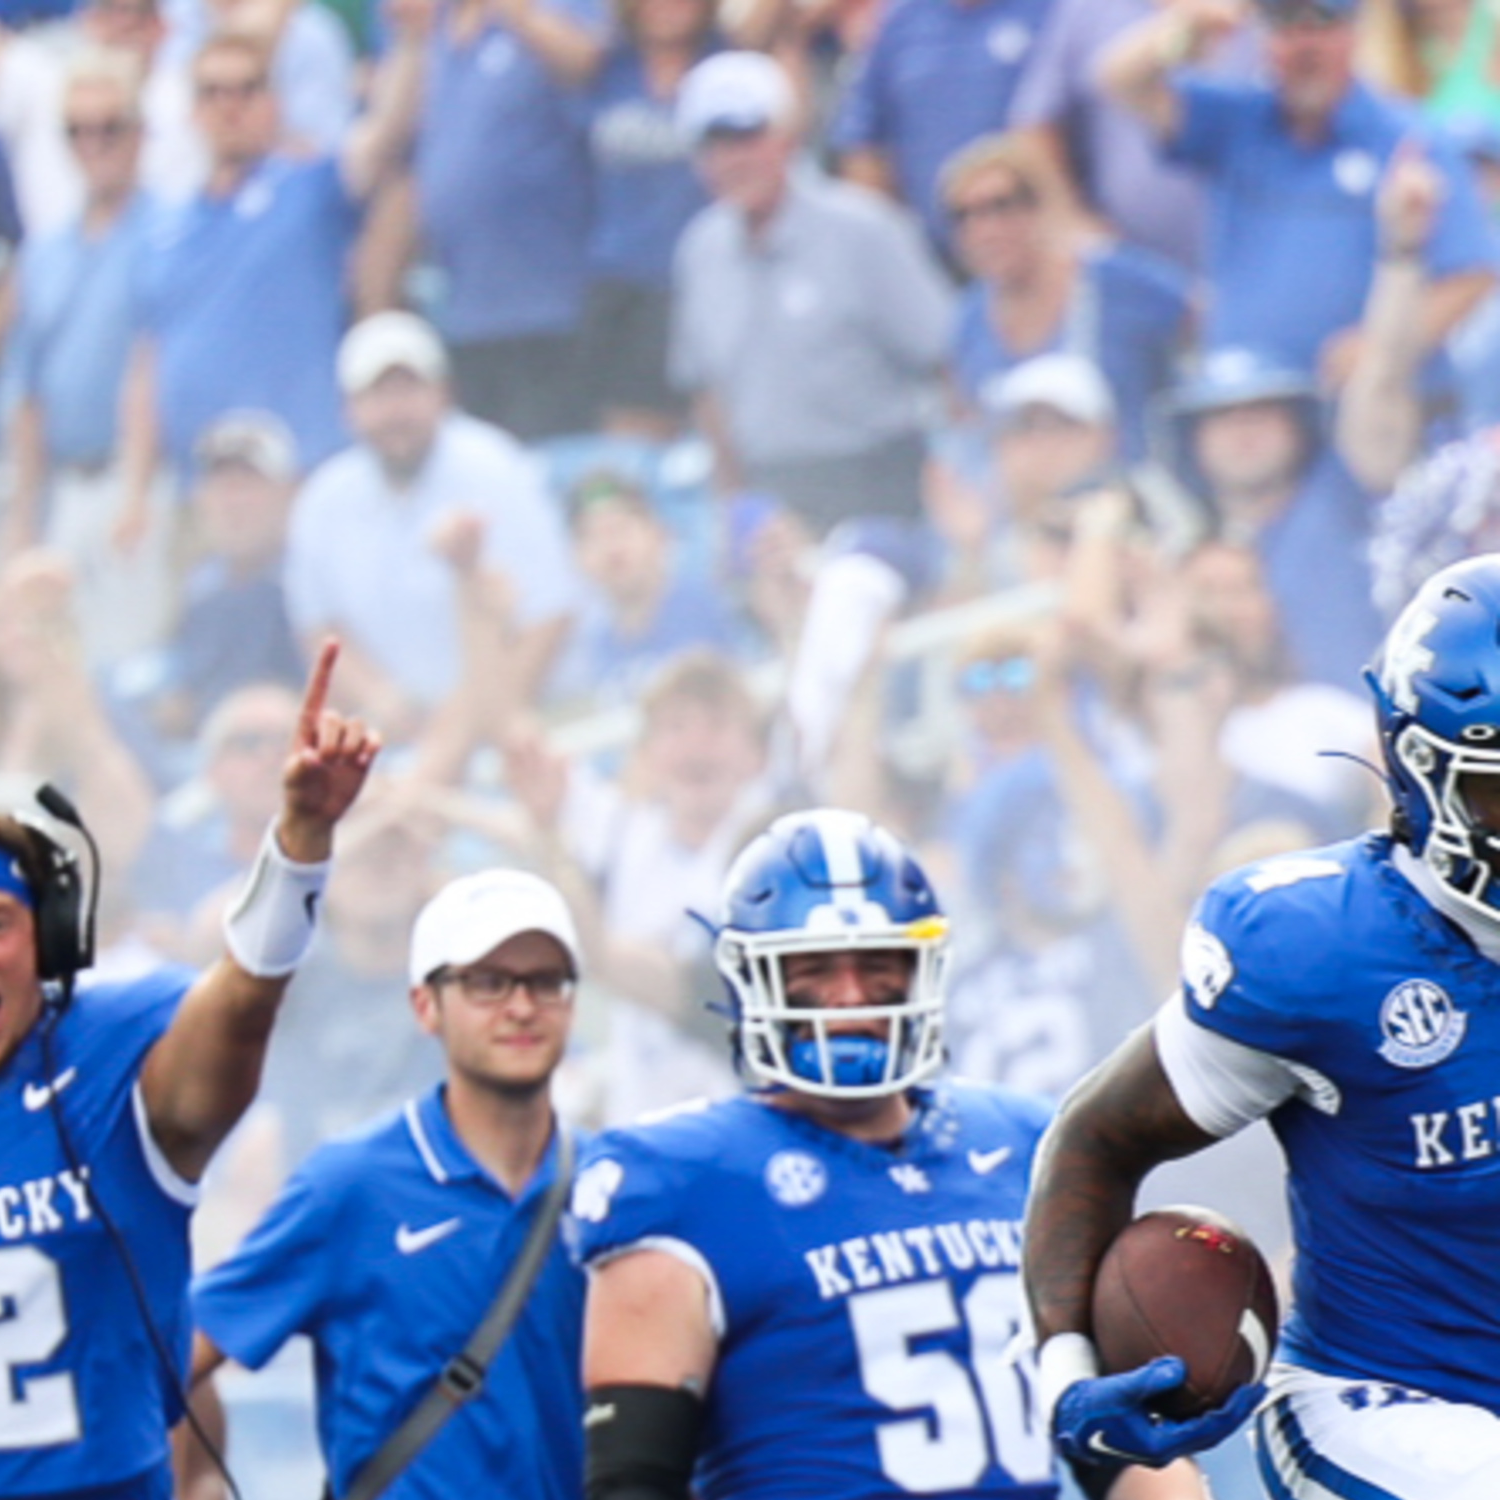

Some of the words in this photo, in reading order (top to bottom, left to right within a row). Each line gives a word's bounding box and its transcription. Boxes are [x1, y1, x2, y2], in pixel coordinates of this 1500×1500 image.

[1384, 982, 1450, 1048] SEC
[1409, 1096, 1500, 1168] KE
[847, 1272, 1052, 1493] 50
